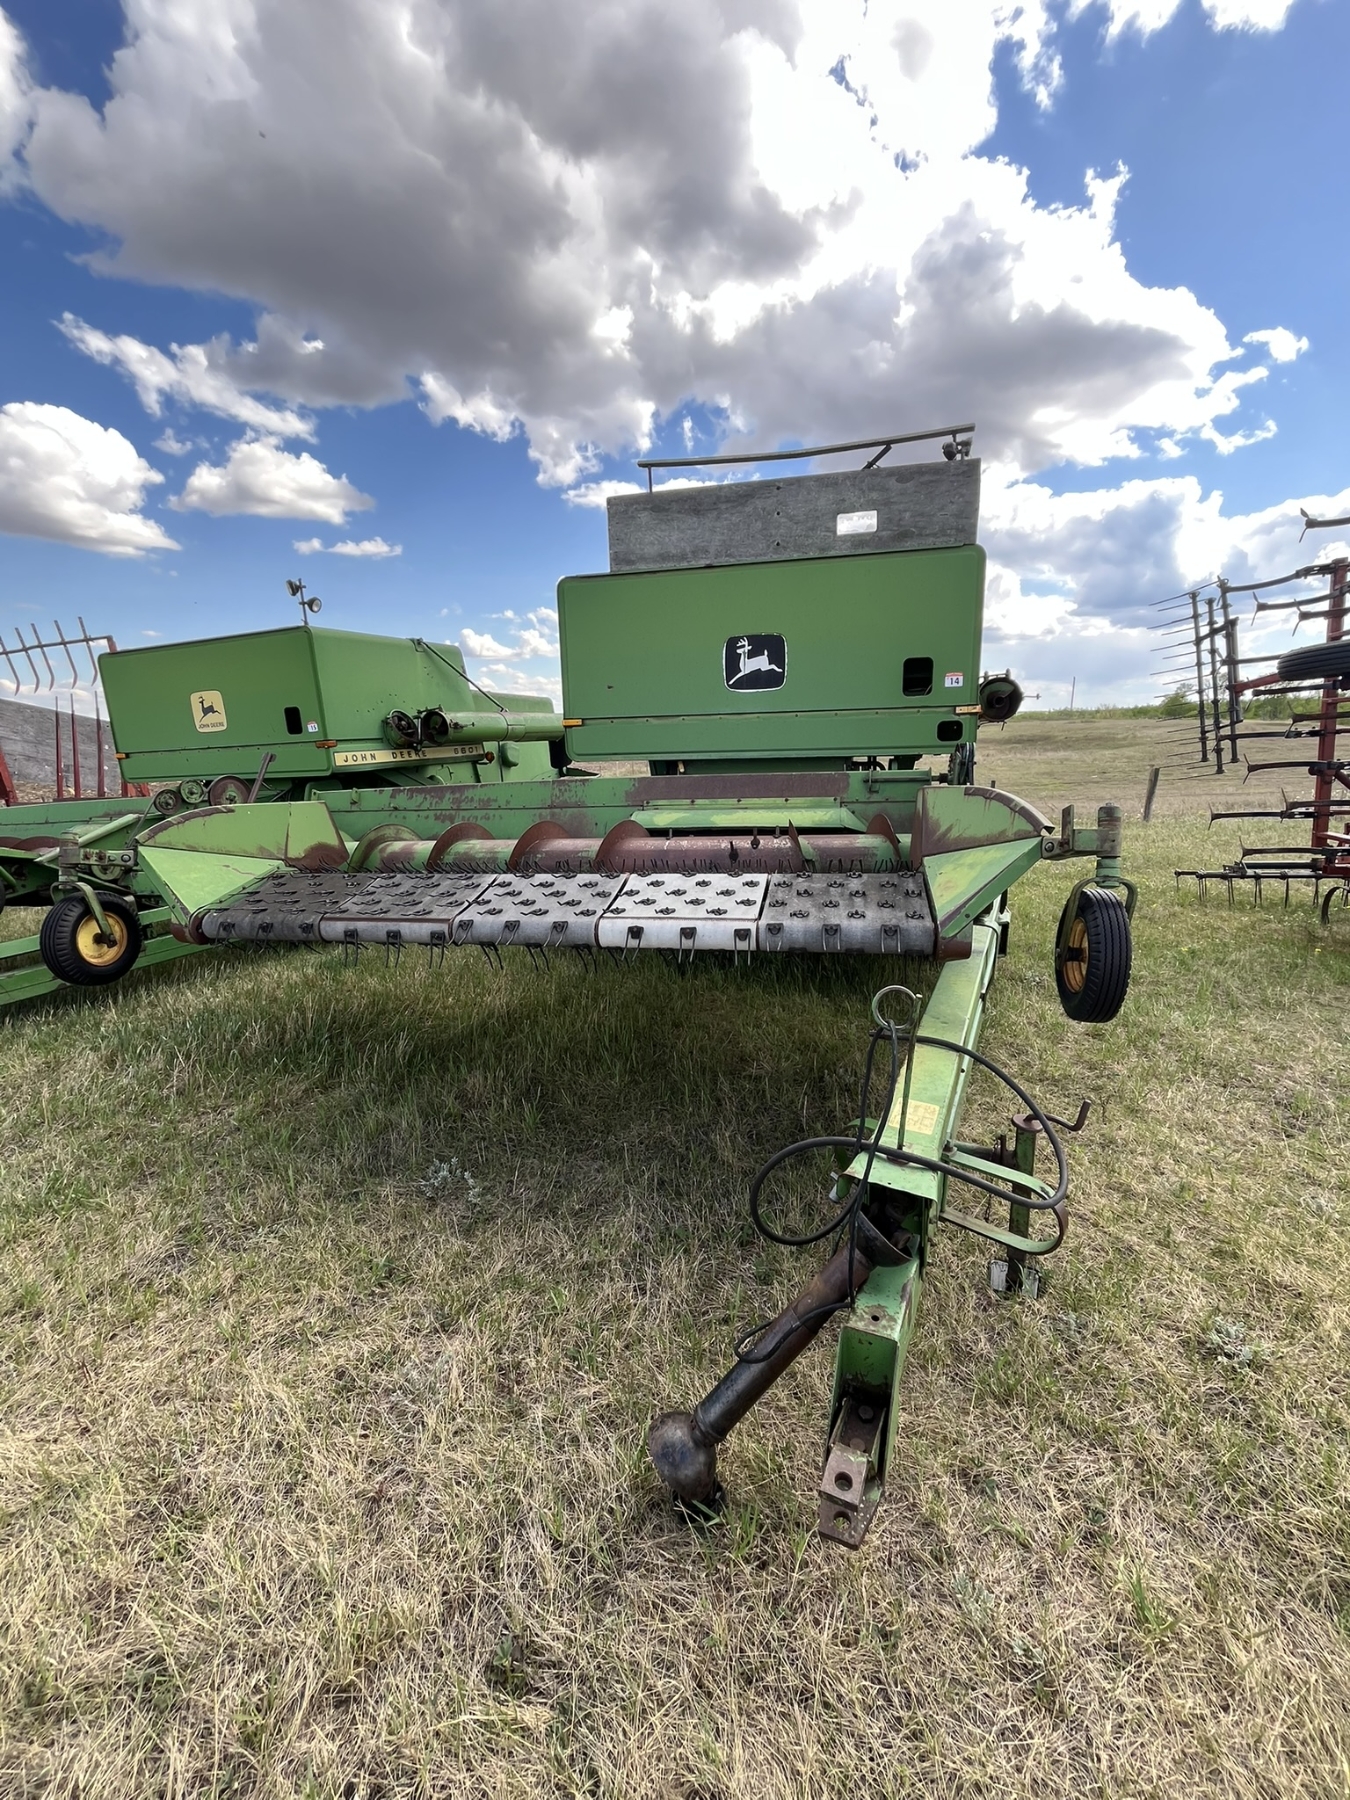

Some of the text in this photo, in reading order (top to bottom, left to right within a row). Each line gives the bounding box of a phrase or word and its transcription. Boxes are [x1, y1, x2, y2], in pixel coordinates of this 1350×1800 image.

[950, 677, 960, 685] 14
[343, 746, 478, 763] JOHN DEERE 6601
